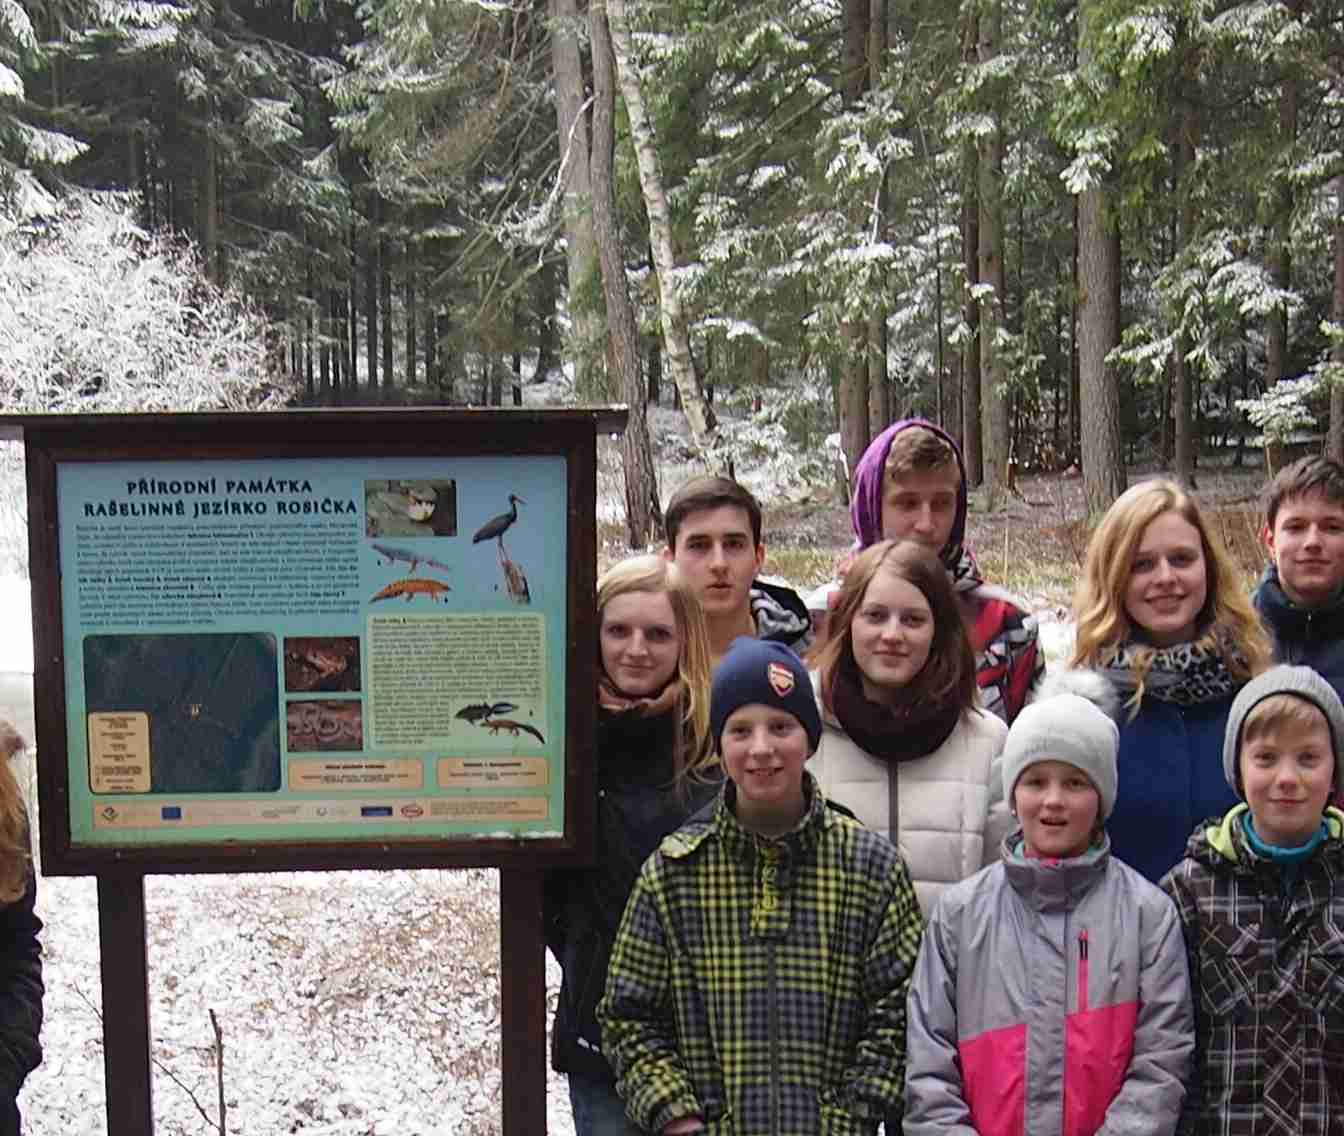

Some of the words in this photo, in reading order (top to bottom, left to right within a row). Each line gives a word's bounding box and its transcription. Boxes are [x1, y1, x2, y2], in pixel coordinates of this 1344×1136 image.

[127, 477, 217, 495] PŘÍRODNÍ
[226, 476, 312, 494] PAMÁTKA
[84, 499, 185, 517] RAŠELINNÉ
[193, 498, 267, 518] JEZÍRKO
[277, 497, 358, 515] ROSIČKA
